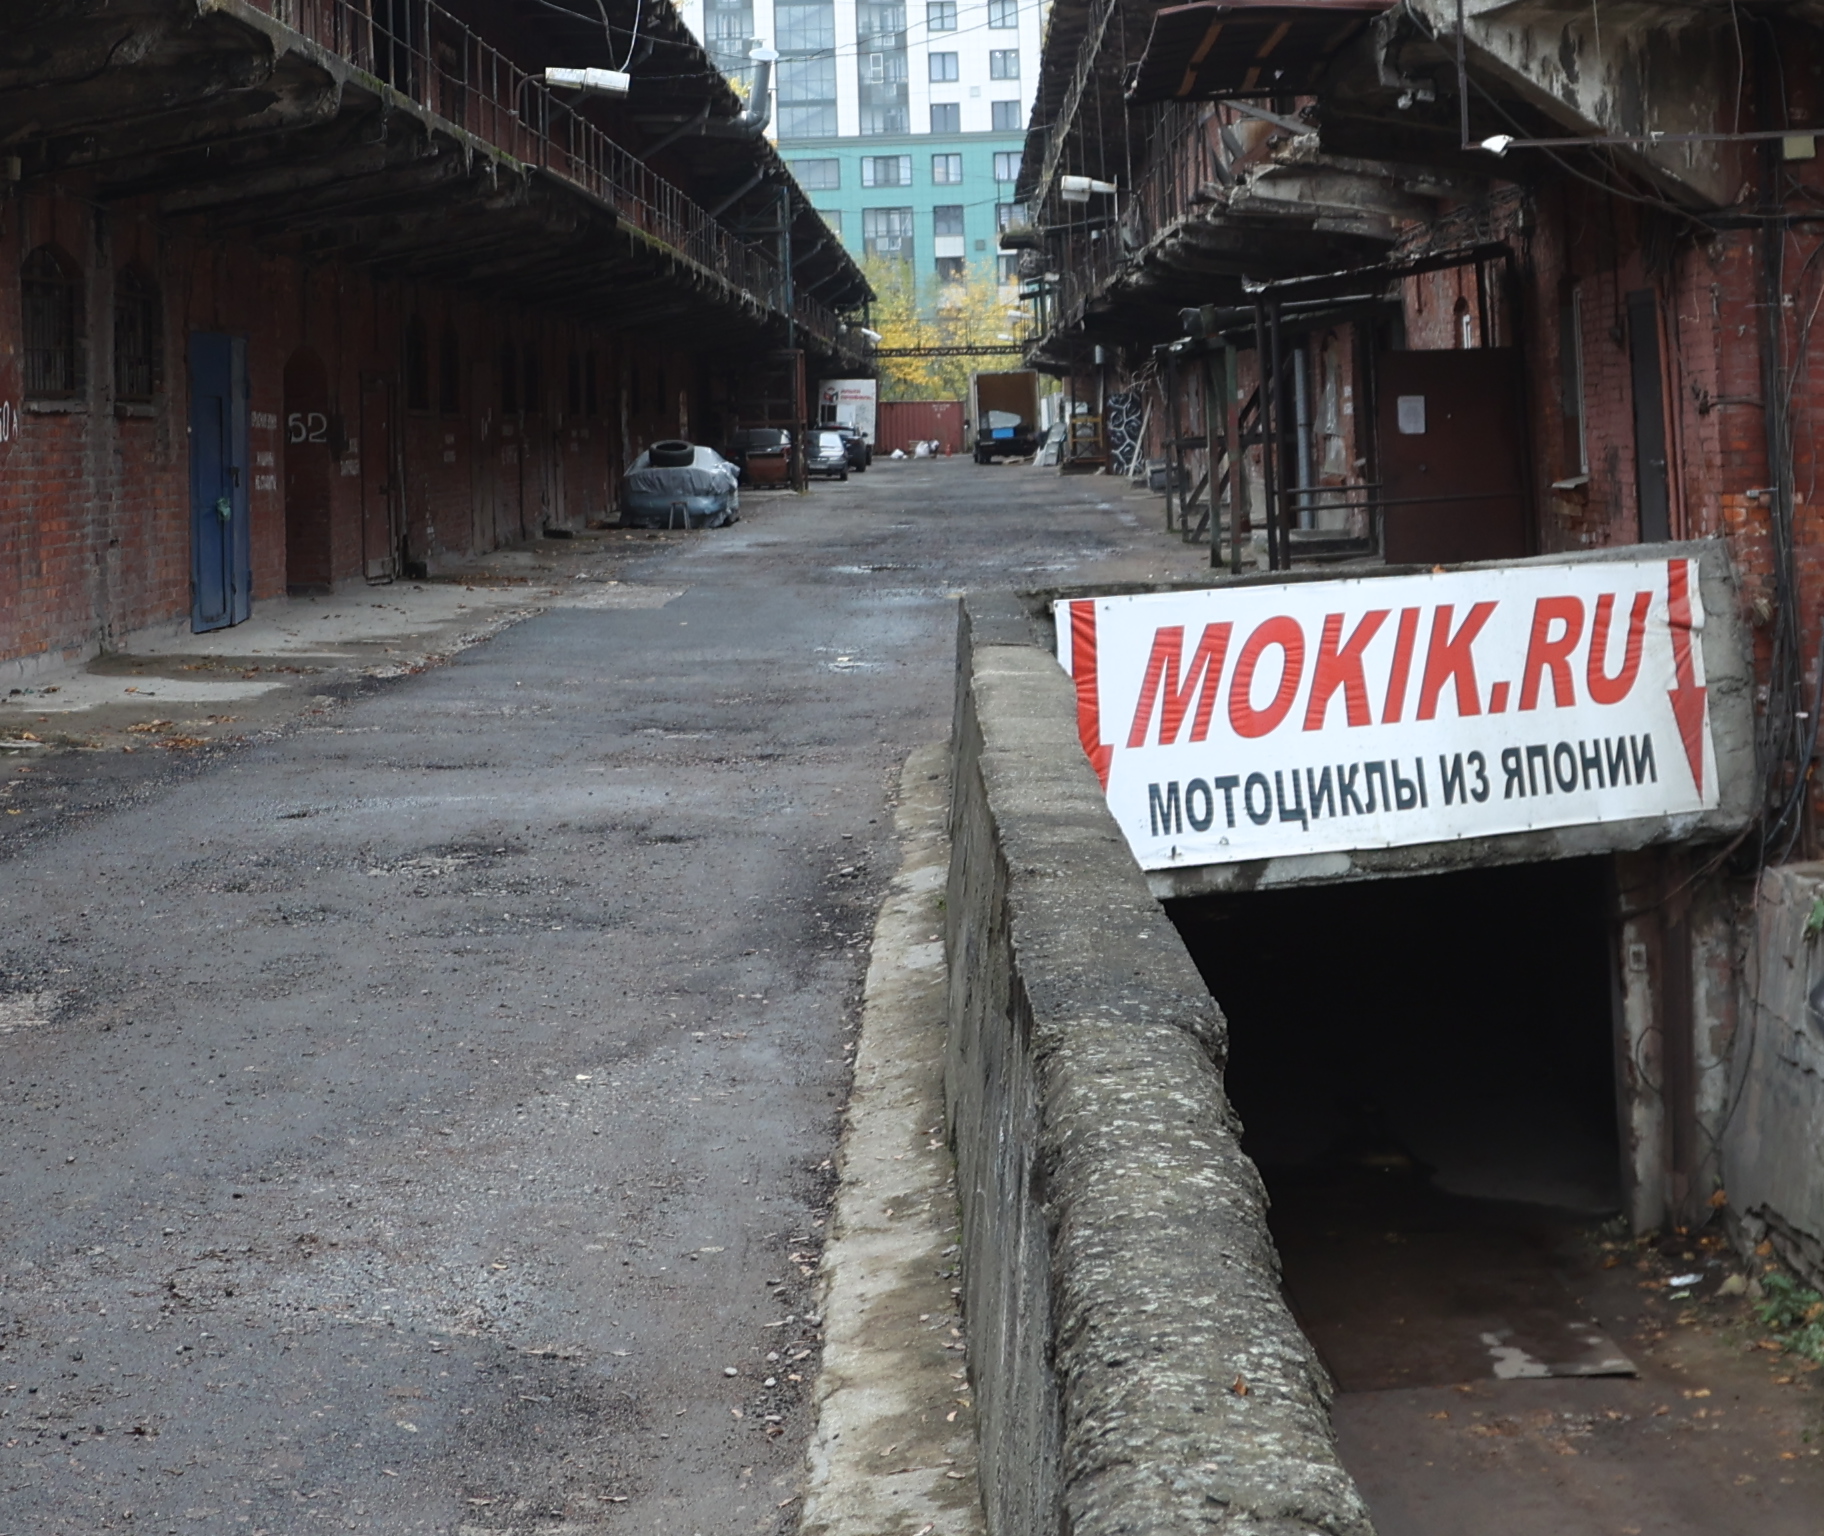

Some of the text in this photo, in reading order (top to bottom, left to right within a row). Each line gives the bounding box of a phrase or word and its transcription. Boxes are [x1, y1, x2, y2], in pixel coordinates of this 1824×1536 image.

[288, 412, 327, 444] 52
[1125, 590, 1653, 749] MOKIK.RU
[1147, 732, 1658, 838] МОТОЦИКЛЫ ИЗ ЯПОНИИ
